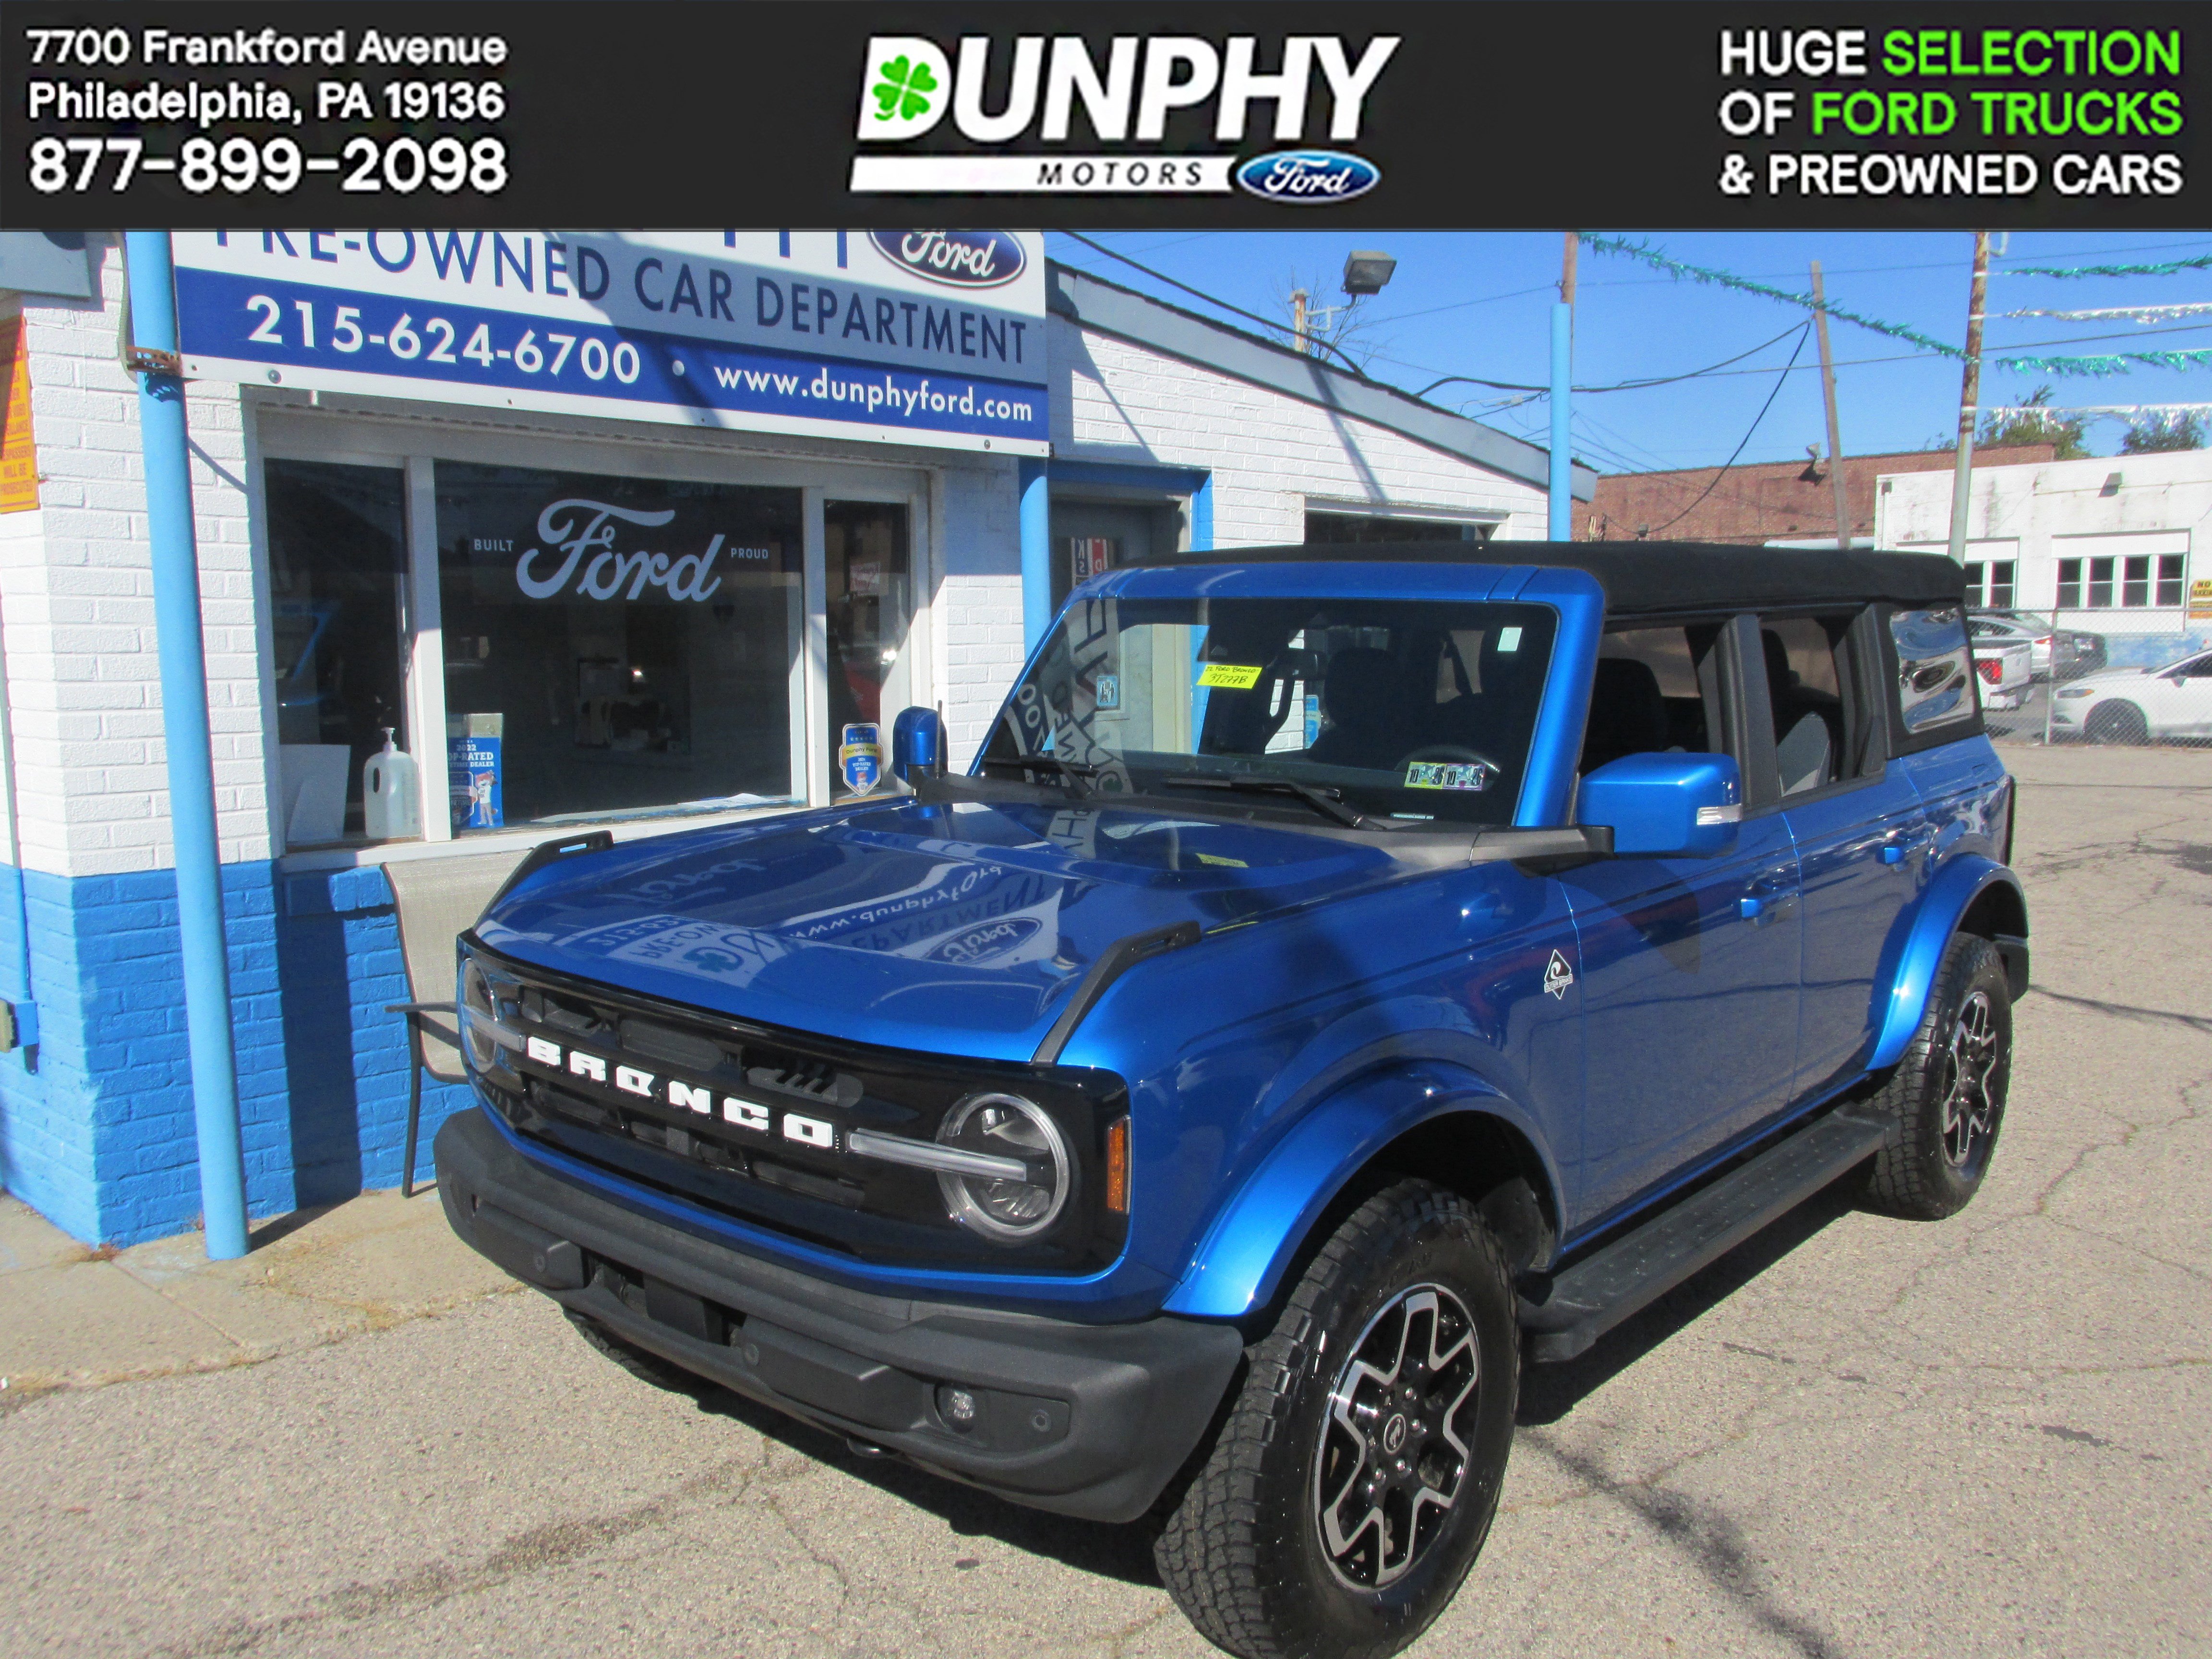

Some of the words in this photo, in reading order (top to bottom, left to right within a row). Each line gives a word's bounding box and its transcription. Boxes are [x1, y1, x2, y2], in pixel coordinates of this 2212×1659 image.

[902, 229, 997, 278] Ford
[247, 295, 640, 384] 215-624-6700
[714, 365, 1033, 421] www.dunphyford.com
[635, 257, 735, 322] CAR
[757, 276, 1027, 364] DEPARTMENT
[473, 539, 514, 553] BUILT
[516, 498, 726, 602] Ford
[730, 547, 769, 560] PROUD
[528, 1036, 833, 1148] BRONCO
